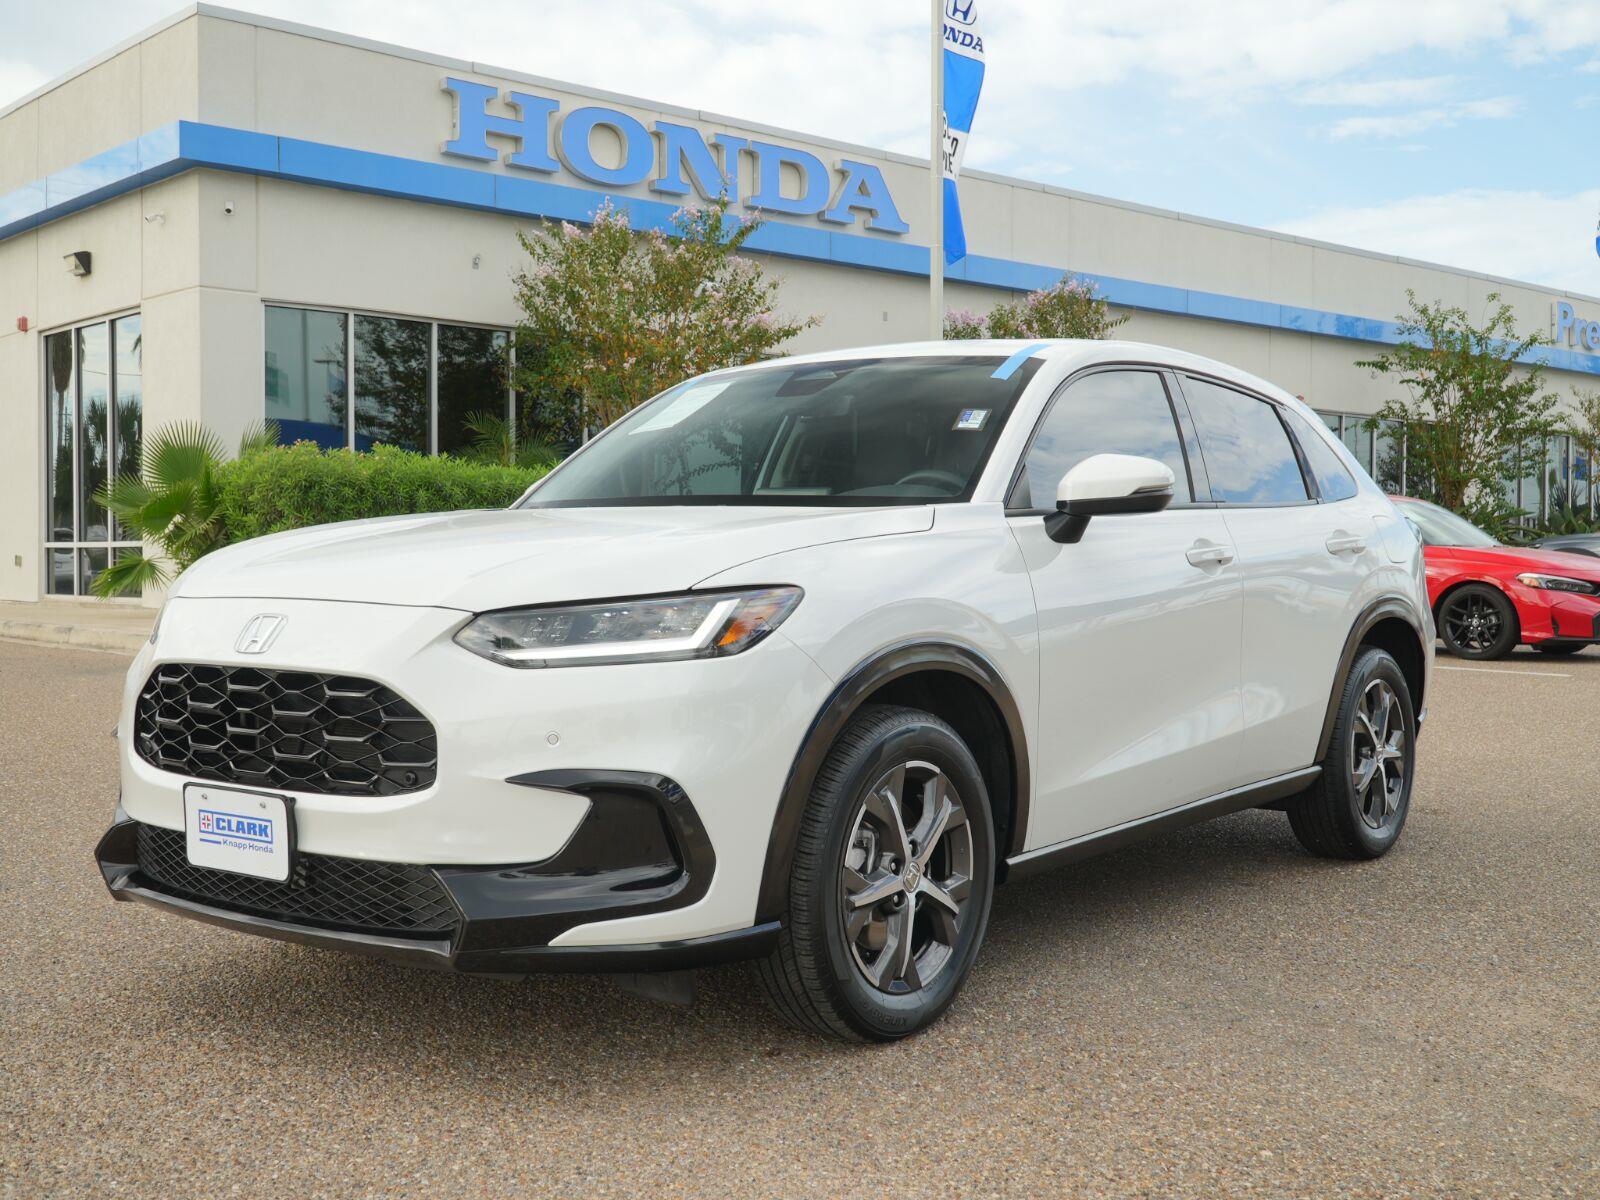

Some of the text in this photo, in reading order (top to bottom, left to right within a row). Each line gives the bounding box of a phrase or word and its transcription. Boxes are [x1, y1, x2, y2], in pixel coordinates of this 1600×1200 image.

[944, 24, 984, 53] NDA
[441, 77, 909, 234] HONDA
[215, 817, 269, 838] CLARK
[222, 838, 274, 854] Knapp Honda
